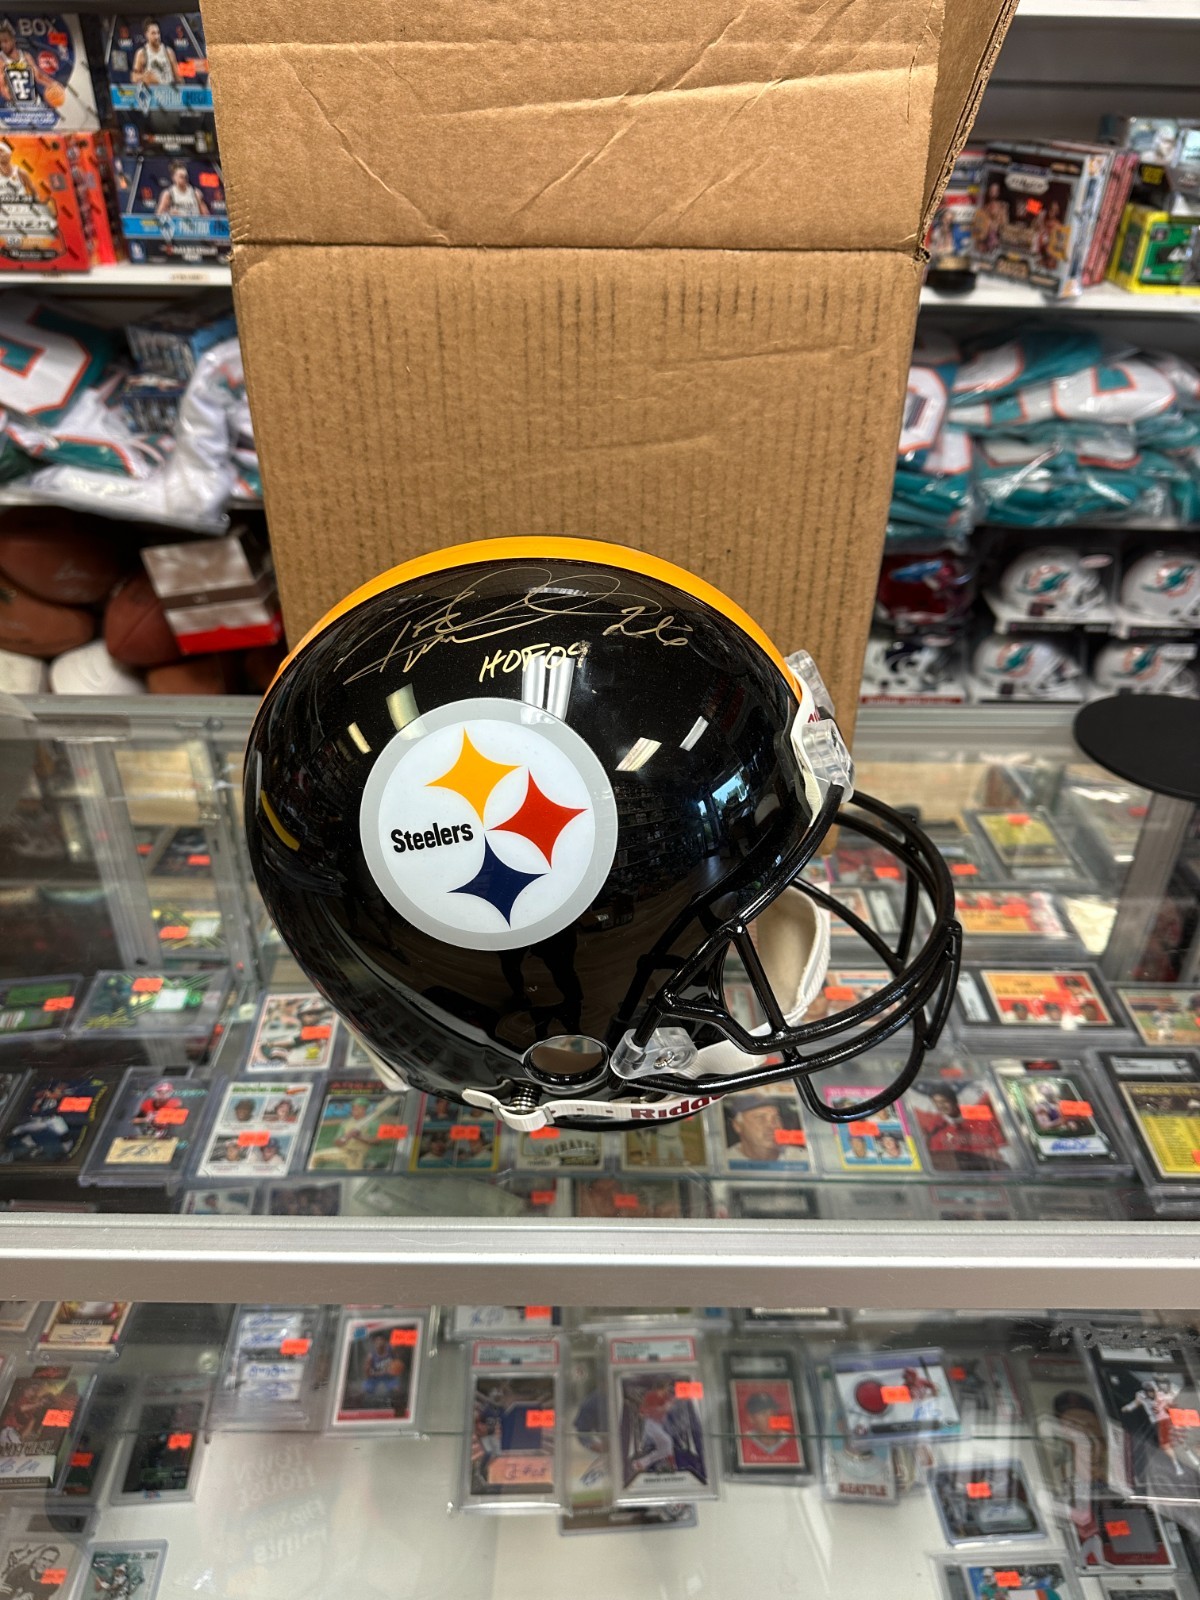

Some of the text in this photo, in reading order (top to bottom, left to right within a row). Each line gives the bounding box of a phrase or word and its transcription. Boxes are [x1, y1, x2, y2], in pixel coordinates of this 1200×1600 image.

[602, 606, 693, 646] 26
[390, 822, 474, 853] Steelers
[630, 1095, 722, 1120] Ridd
